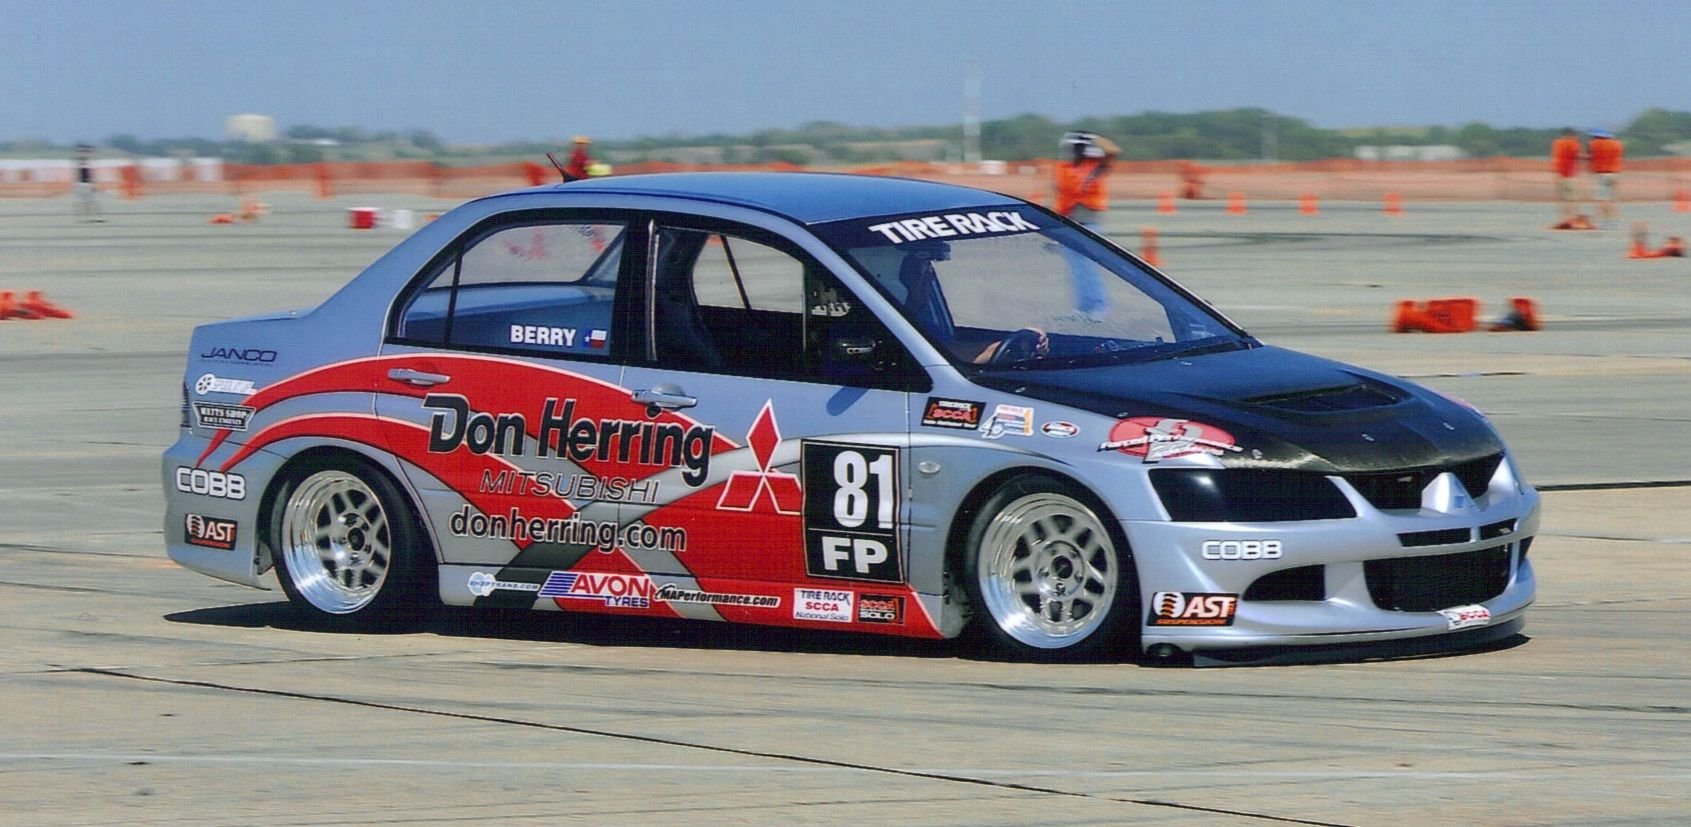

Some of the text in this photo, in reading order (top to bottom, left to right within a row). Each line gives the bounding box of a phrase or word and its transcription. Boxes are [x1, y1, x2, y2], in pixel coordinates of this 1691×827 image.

[510, 324, 577, 347] BERRY
[201, 347, 277, 362] JANCO
[932, 409, 971, 421] SCCA
[422, 393, 715, 487] Don Herring
[176, 466, 247, 500] COBB
[480, 469, 661, 503] MITSUBISHI
[833, 450, 894, 529] 81
[205, 521, 235, 542] AST
[450, 504, 688, 553] donherring.com
[822, 536, 888, 574] FP
[1202, 540, 1283, 560] COBB
[571, 574, 649, 597] AVON
[606, 595, 649, 607] TYRES
[660, 588, 779, 607] MAPerformance.com
[801, 590, 850, 606] TIRE RACK
[805, 602, 840, 611] SCCA
[1182, 596, 1236, 618] AST
[795, 611, 849, 621] National Solo
[859, 610, 896, 620] SOLO
